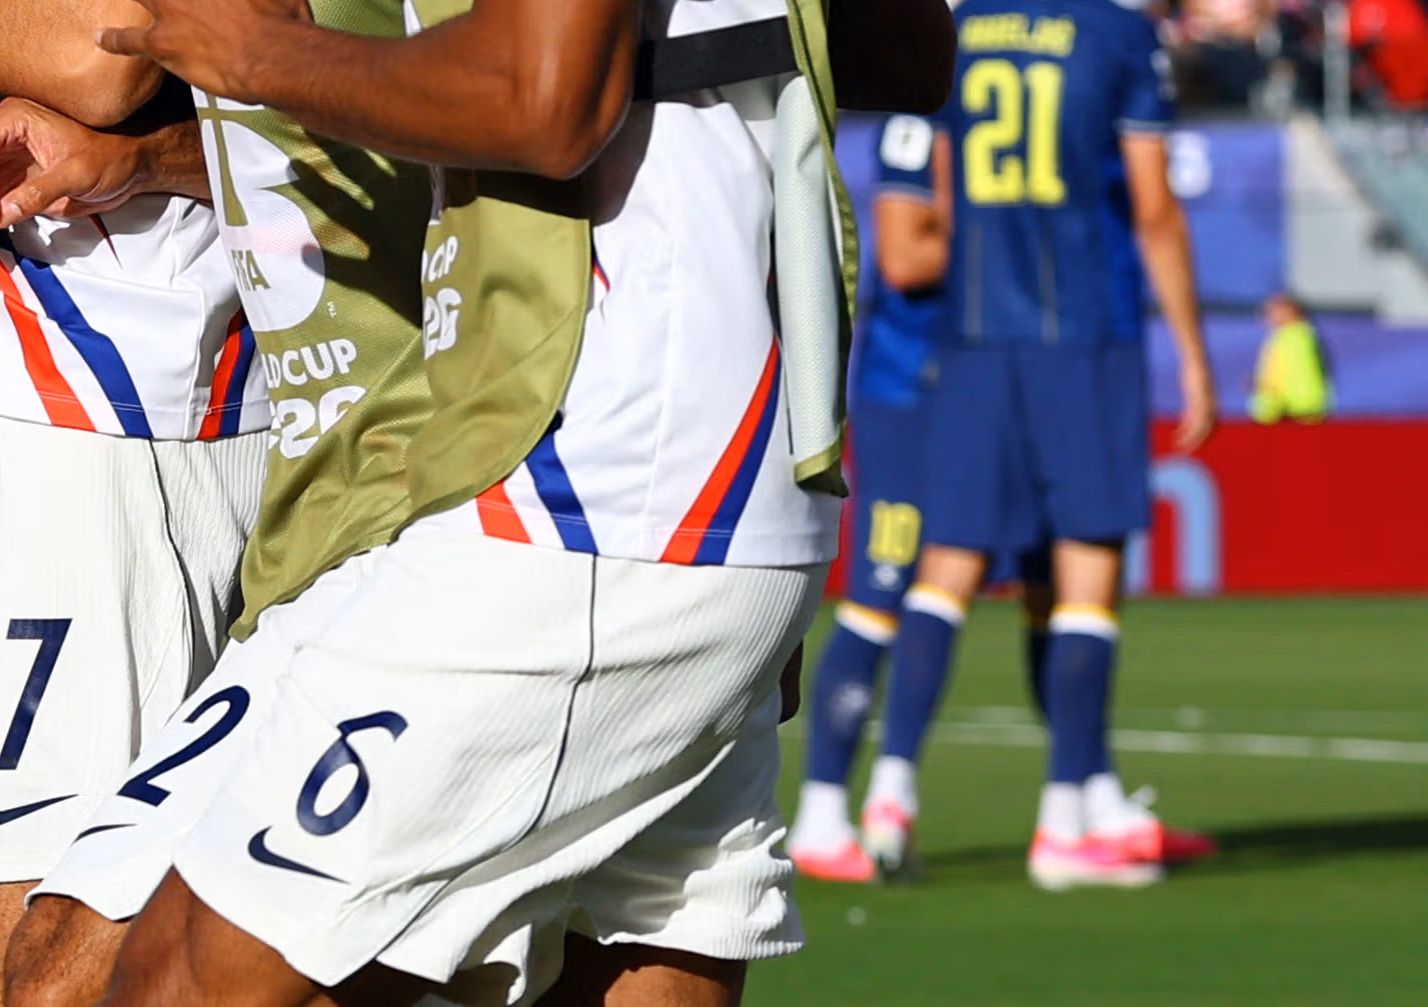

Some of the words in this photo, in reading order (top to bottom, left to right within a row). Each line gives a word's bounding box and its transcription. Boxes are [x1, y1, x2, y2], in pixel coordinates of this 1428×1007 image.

[960, 58, 1066, 206] 21
[117, 685, 251, 807] 2
[296, 710, 408, 837] 6
